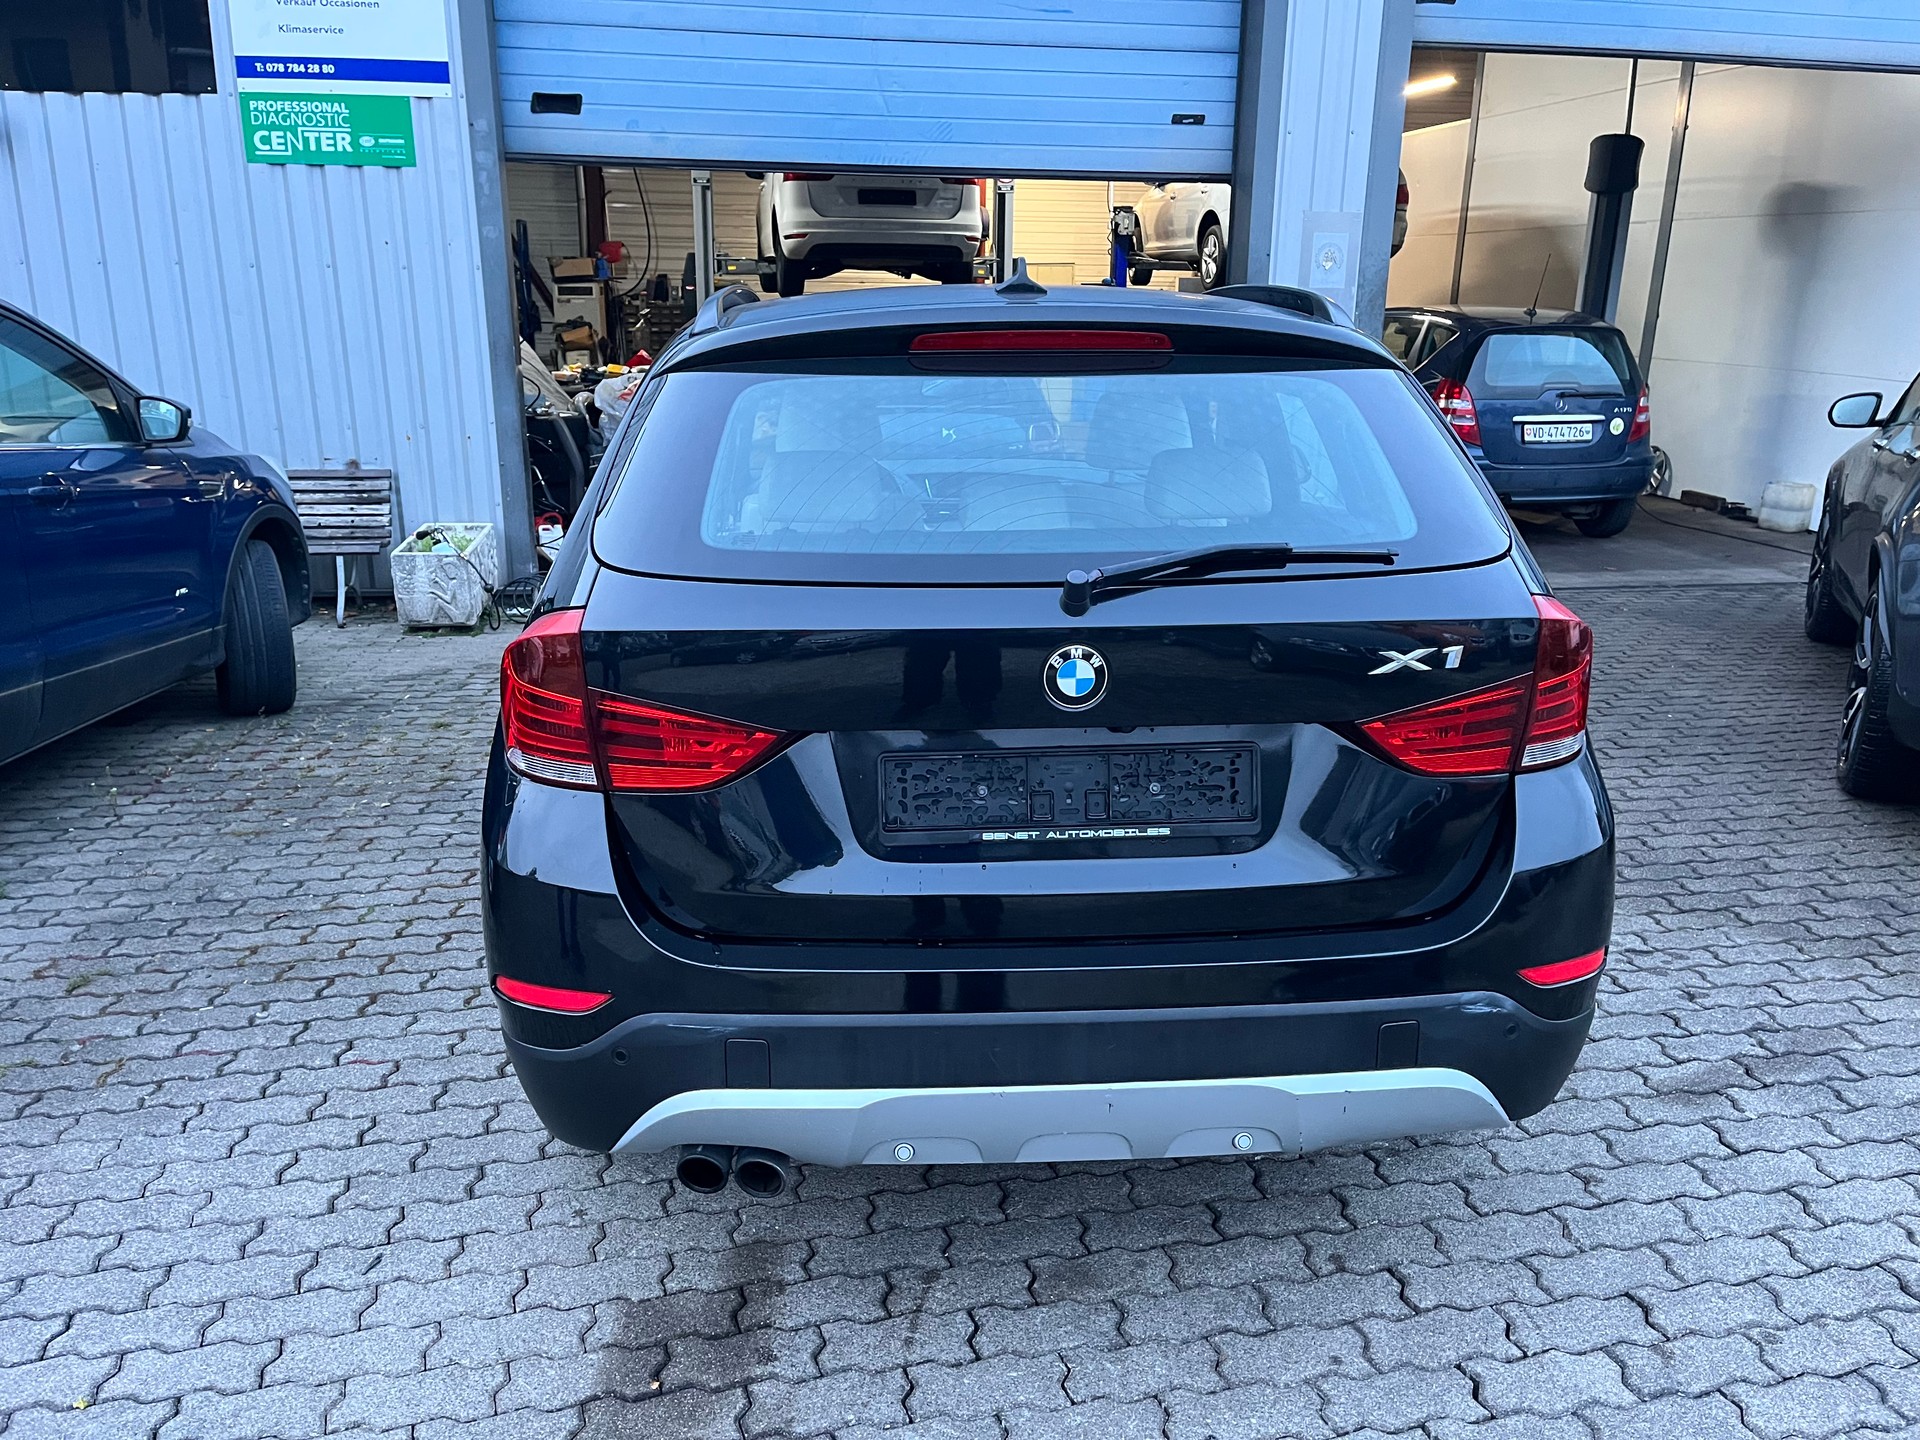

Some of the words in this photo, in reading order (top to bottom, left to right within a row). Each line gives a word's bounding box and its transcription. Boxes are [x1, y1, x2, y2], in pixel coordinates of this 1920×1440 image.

[320, 0, 380, 8] Occasionen
[278, 24, 344, 35] Klimaservice
[255, 63, 265, 72] T:
[266, 63, 285, 72] 078
[286, 63, 306, 73] 784
[307, 64, 320, 73] 28
[322, 64, 335, 74] 80
[249, 100, 350, 113] PROFESSIONAL
[250, 111, 351, 127] DIAGNOSTIC
[253, 127, 354, 155] CENTER
[1050, 648, 1103, 669] BMW
[1367, 645, 1465, 675] X1
[982, 831, 1041, 841] BENET
[1045, 827, 1171, 840] AUTOMOBILES
